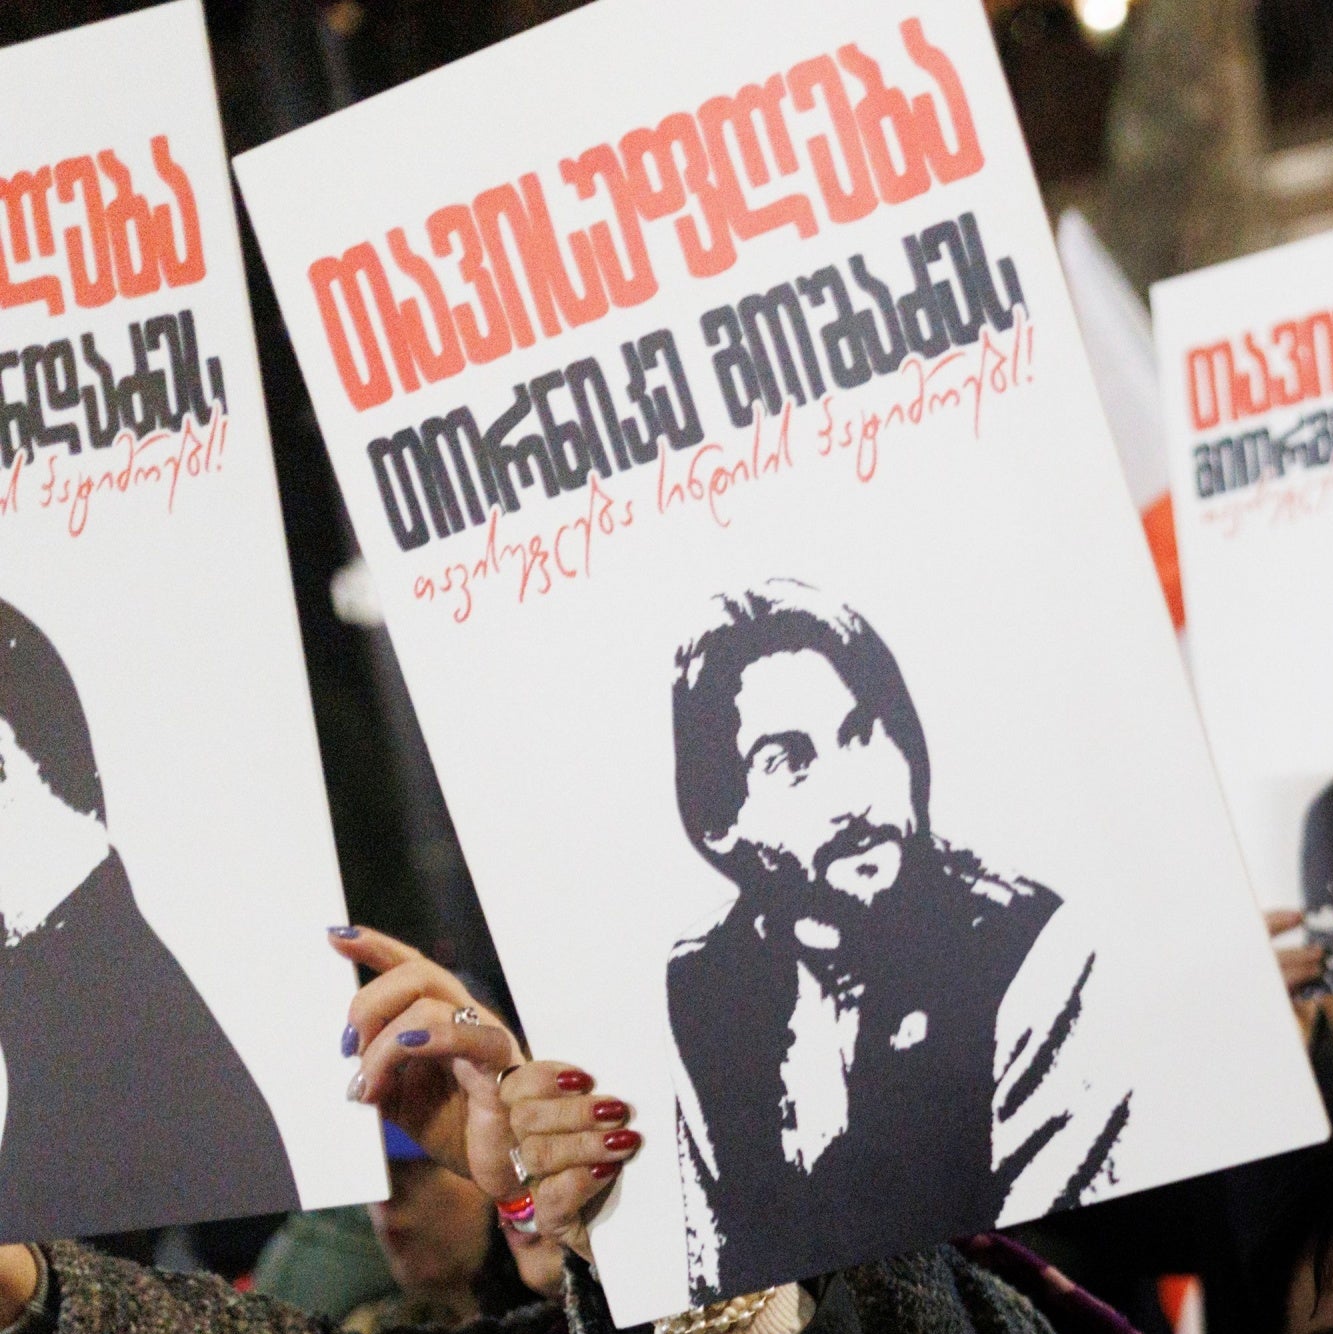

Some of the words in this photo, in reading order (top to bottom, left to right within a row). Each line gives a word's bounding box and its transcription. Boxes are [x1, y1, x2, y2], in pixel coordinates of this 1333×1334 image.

[307, 18, 985, 411] თავისუფლება
[366, 328, 704, 552] თორნიკე
[700, 210, 1030, 428] გოშაძეს
